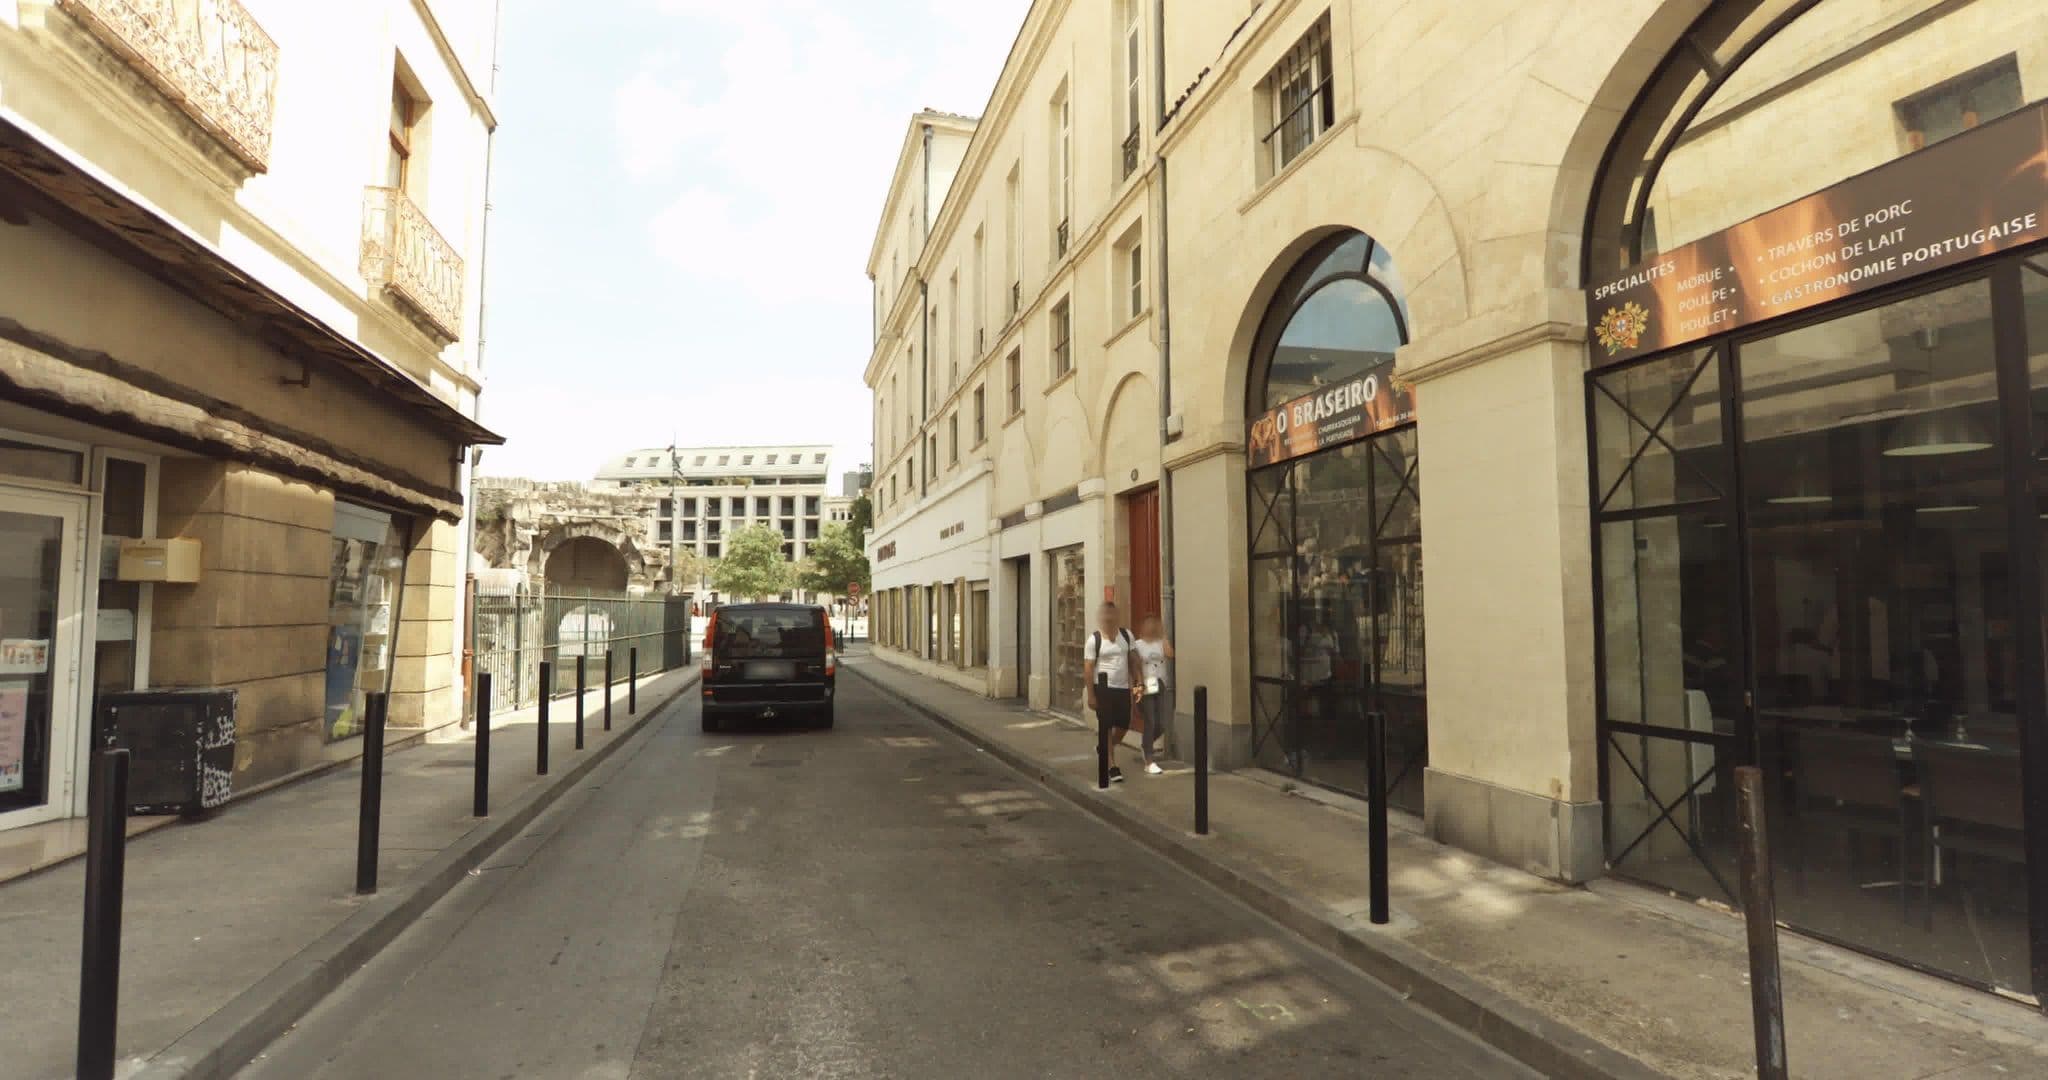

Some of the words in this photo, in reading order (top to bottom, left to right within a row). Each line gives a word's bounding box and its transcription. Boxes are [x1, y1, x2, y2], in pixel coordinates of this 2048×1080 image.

[1767, 227, 1834, 261] TRAVERS
[1838, 218, 1860, 238] DE
[1864, 199, 1913, 228] PORC
[1676, 267, 1723, 293] MORUE
[1769, 251, 1837, 284] COCHON
[1841, 241, 1864, 261] DE
[1868, 227, 1906, 252] LAIT
[1771, 256, 1897, 306] GASTRONOMIE
[1901, 212, 2038, 267] PORTUGAISE
[1594, 260, 1676, 301] SPECIALITES
[1678, 286, 1728, 314] POULPE
[1680, 307, 1729, 333] POULET
[1276, 410, 1288, 434] O
[1293, 373, 1378, 428] BRASEIRO
